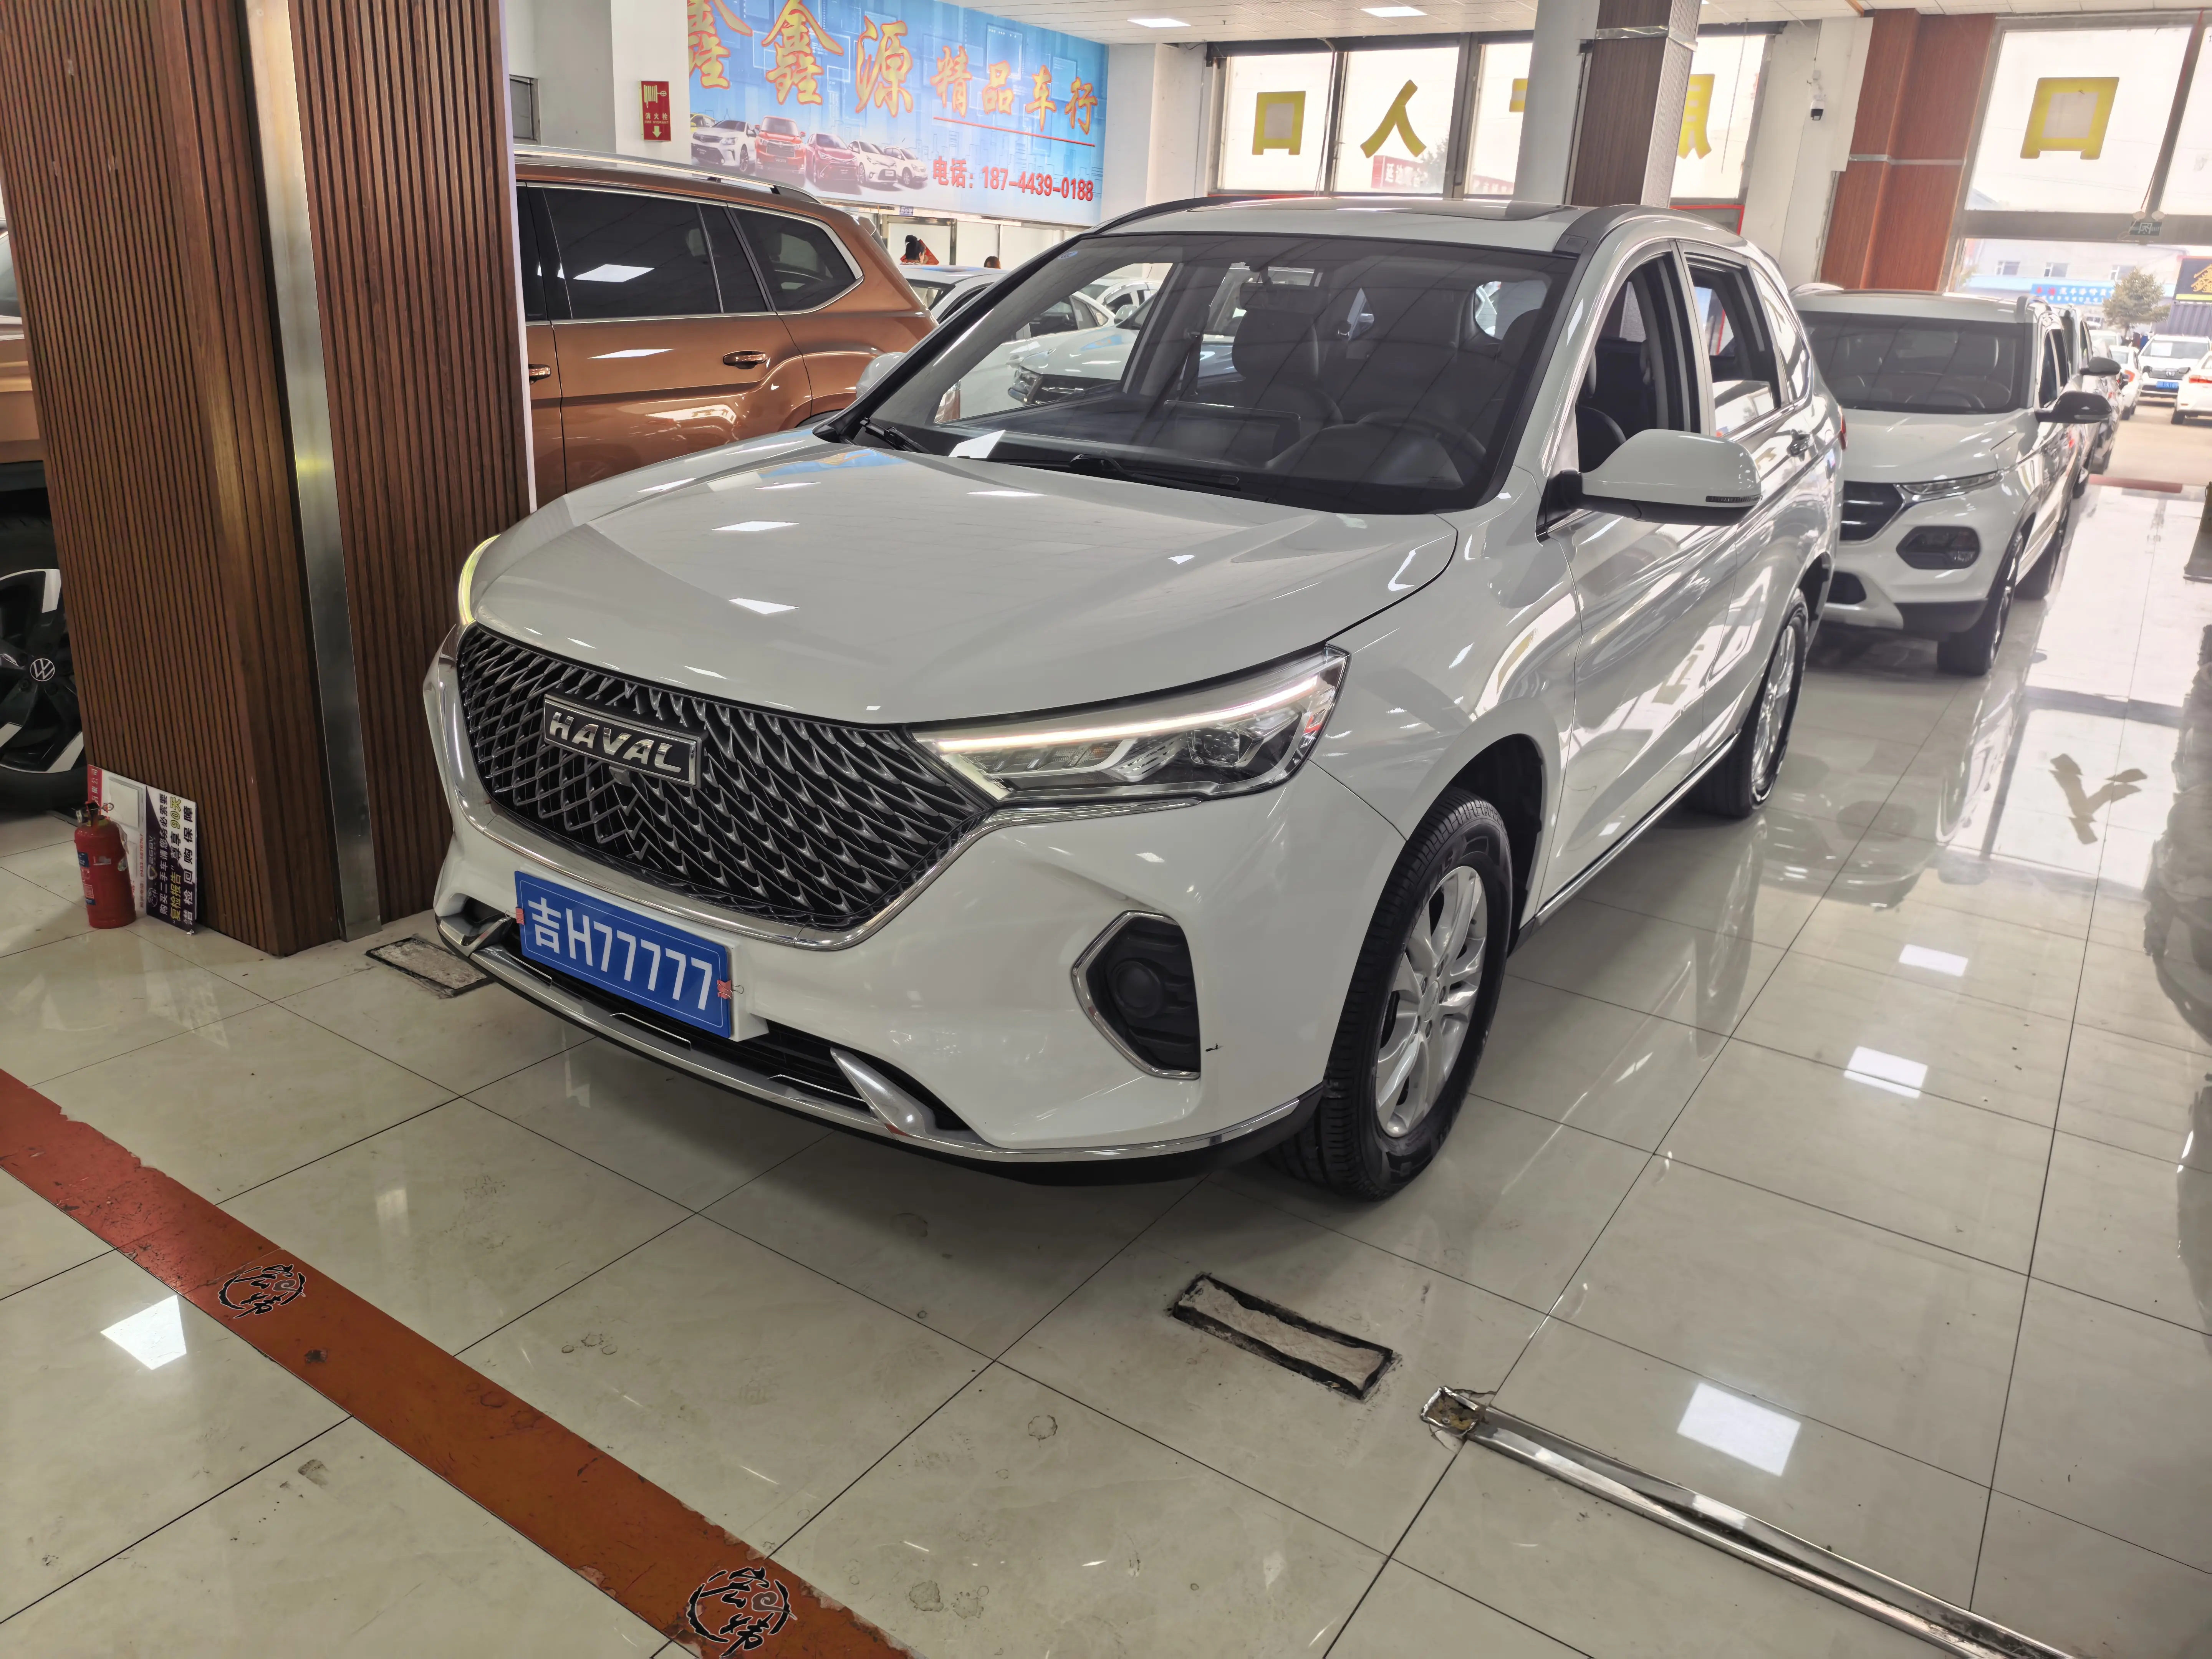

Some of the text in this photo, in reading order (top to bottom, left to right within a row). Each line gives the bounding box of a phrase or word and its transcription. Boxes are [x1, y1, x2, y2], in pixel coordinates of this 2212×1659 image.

[929, 45, 1098, 136] 精品车行
[982, 166, 1094, 201] 187-4439-0188
[549, 711, 682, 773] HAVAL
[528, 897, 713, 1010] 吉H77777
